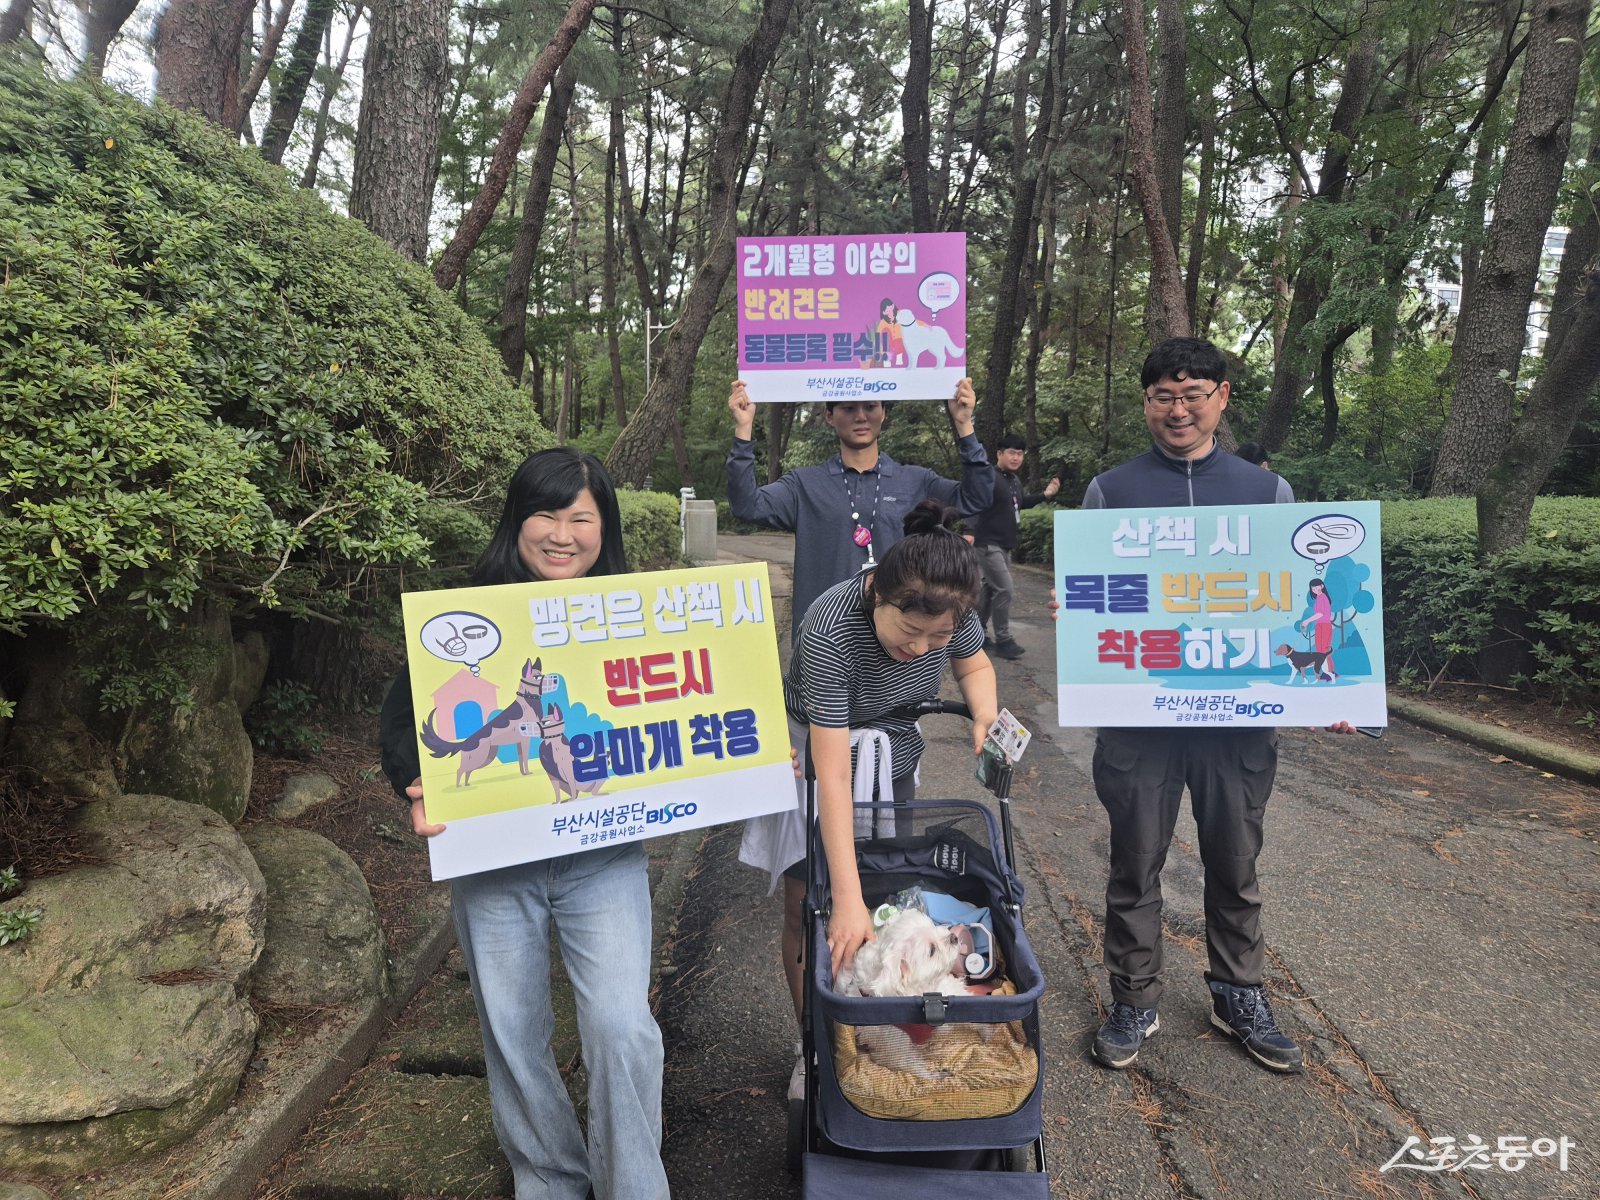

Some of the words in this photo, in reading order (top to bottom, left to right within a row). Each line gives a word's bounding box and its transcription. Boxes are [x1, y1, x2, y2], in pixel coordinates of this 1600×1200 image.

[743, 243, 835, 277] 2개월령
[844, 241, 917, 275] 이상의
[744, 287, 840, 320] 반려견은
[744, 333, 827, 364] 동물등록
[832, 332, 889, 363] 필수!!
[806, 377, 864, 389] 부산시설공단
[863, 380, 897, 393] BISCO
[1111, 515, 1196, 558] 산책
[1208, 514, 1251, 556] 시
[1064, 573, 1149, 614] 목줄
[1161, 570, 1293, 613] 반드시
[527, 588, 646, 649] 맹견은
[652, 580, 724, 633] 산책
[731, 577, 765, 626] 시
[1097, 628, 1272, 670] 착용하기
[603, 647, 715, 707] 반드시
[1153, 695, 1236, 711] 부산시설공단
[1235, 701, 1284, 719] BISCO
[1175, 712, 1234, 722] 금강공원사업소
[569, 717, 683, 784] 입마개
[689, 707, 761, 761] 착용
[551, 801, 646, 836] 부산시설공단
[645, 801, 698, 826] BISCO
[580, 824, 645, 846] 금강공원사업소
